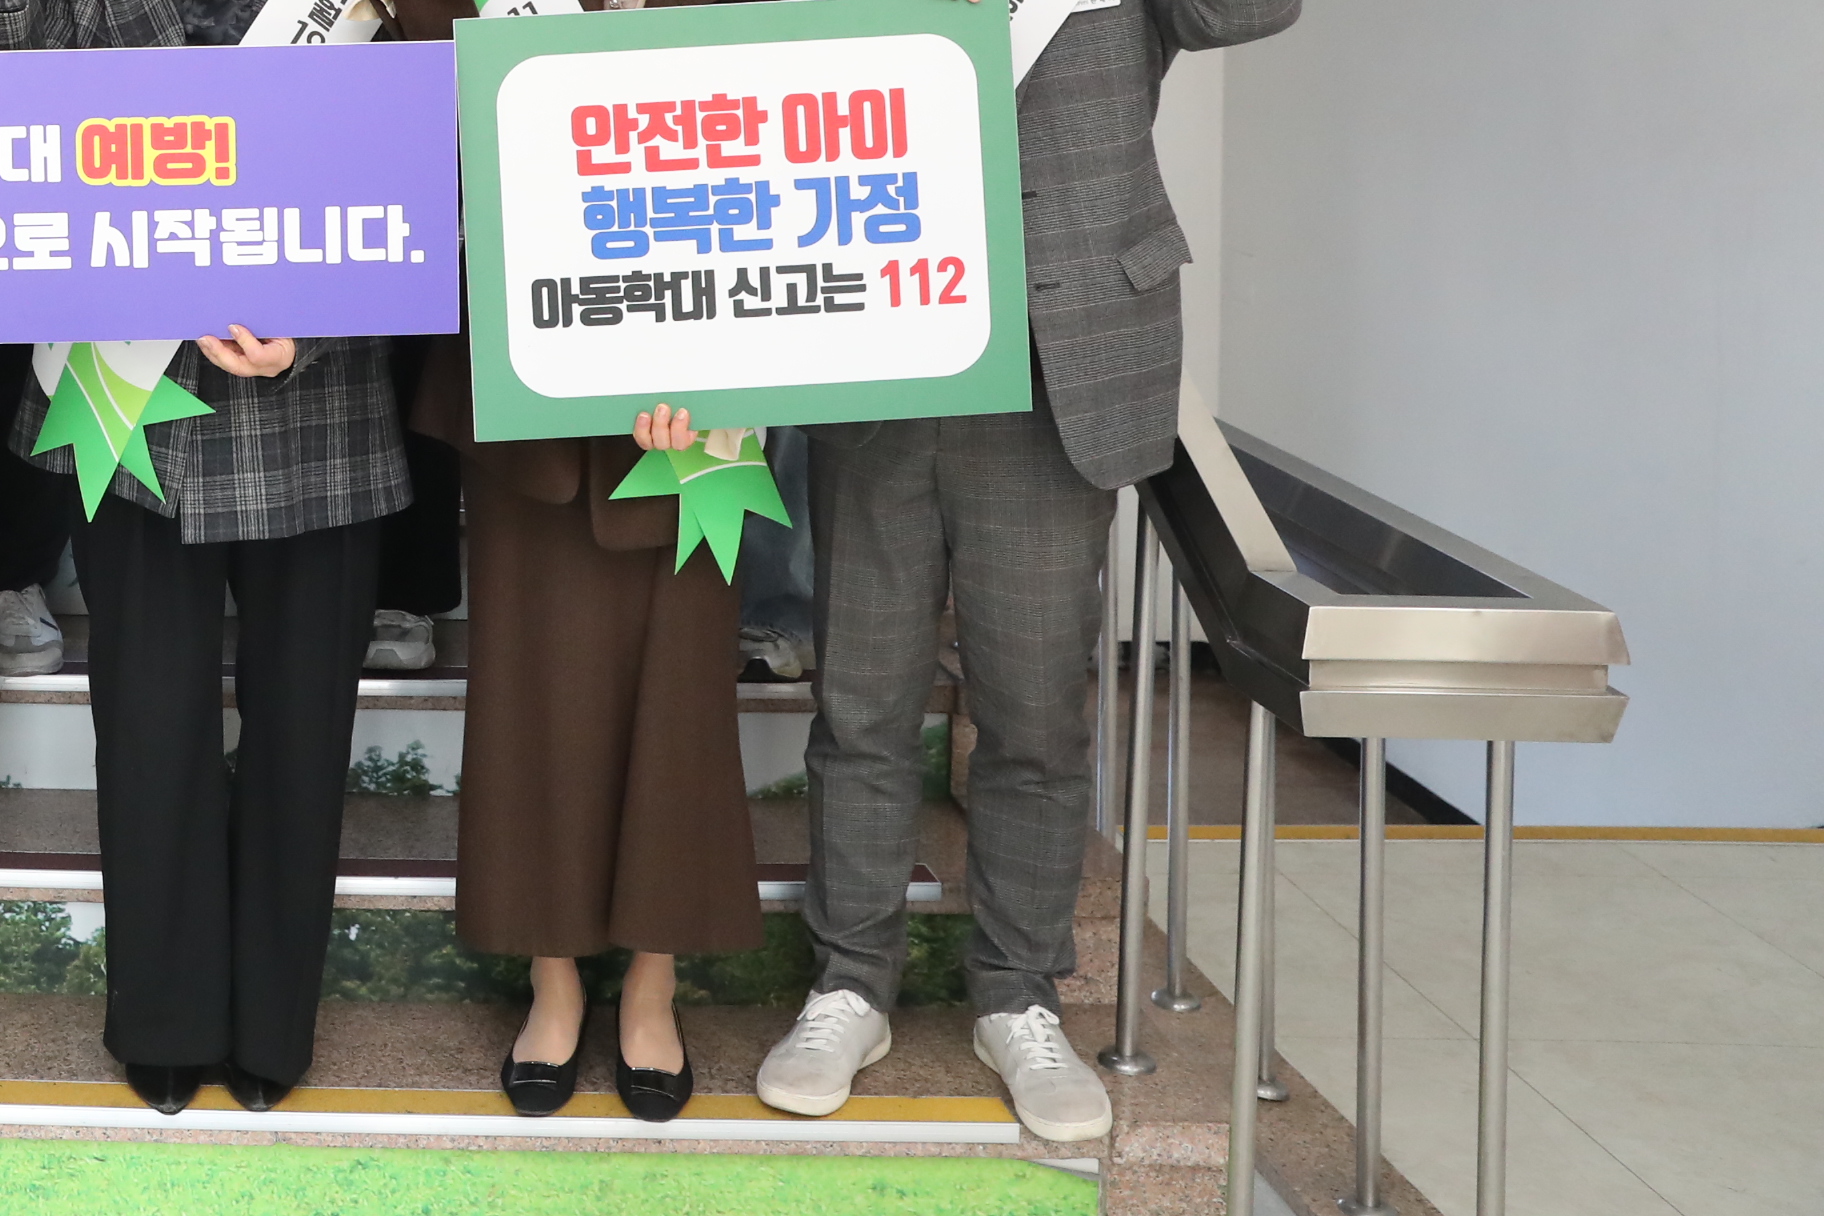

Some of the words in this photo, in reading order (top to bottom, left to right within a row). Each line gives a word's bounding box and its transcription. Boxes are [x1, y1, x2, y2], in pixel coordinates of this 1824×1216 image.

[77, 115, 238, 187] 예방!
[570, 93, 768, 176] 안전한
[781, 88, 909, 164] 아이
[90, 204, 426, 269] 시작됩니다.
[581, 177, 781, 260] 행복한
[794, 171, 922, 248] 가정
[530, 269, 717, 329] 아동학대
[728, 262, 867, 318] 신고는
[879, 256, 968, 308] 112
